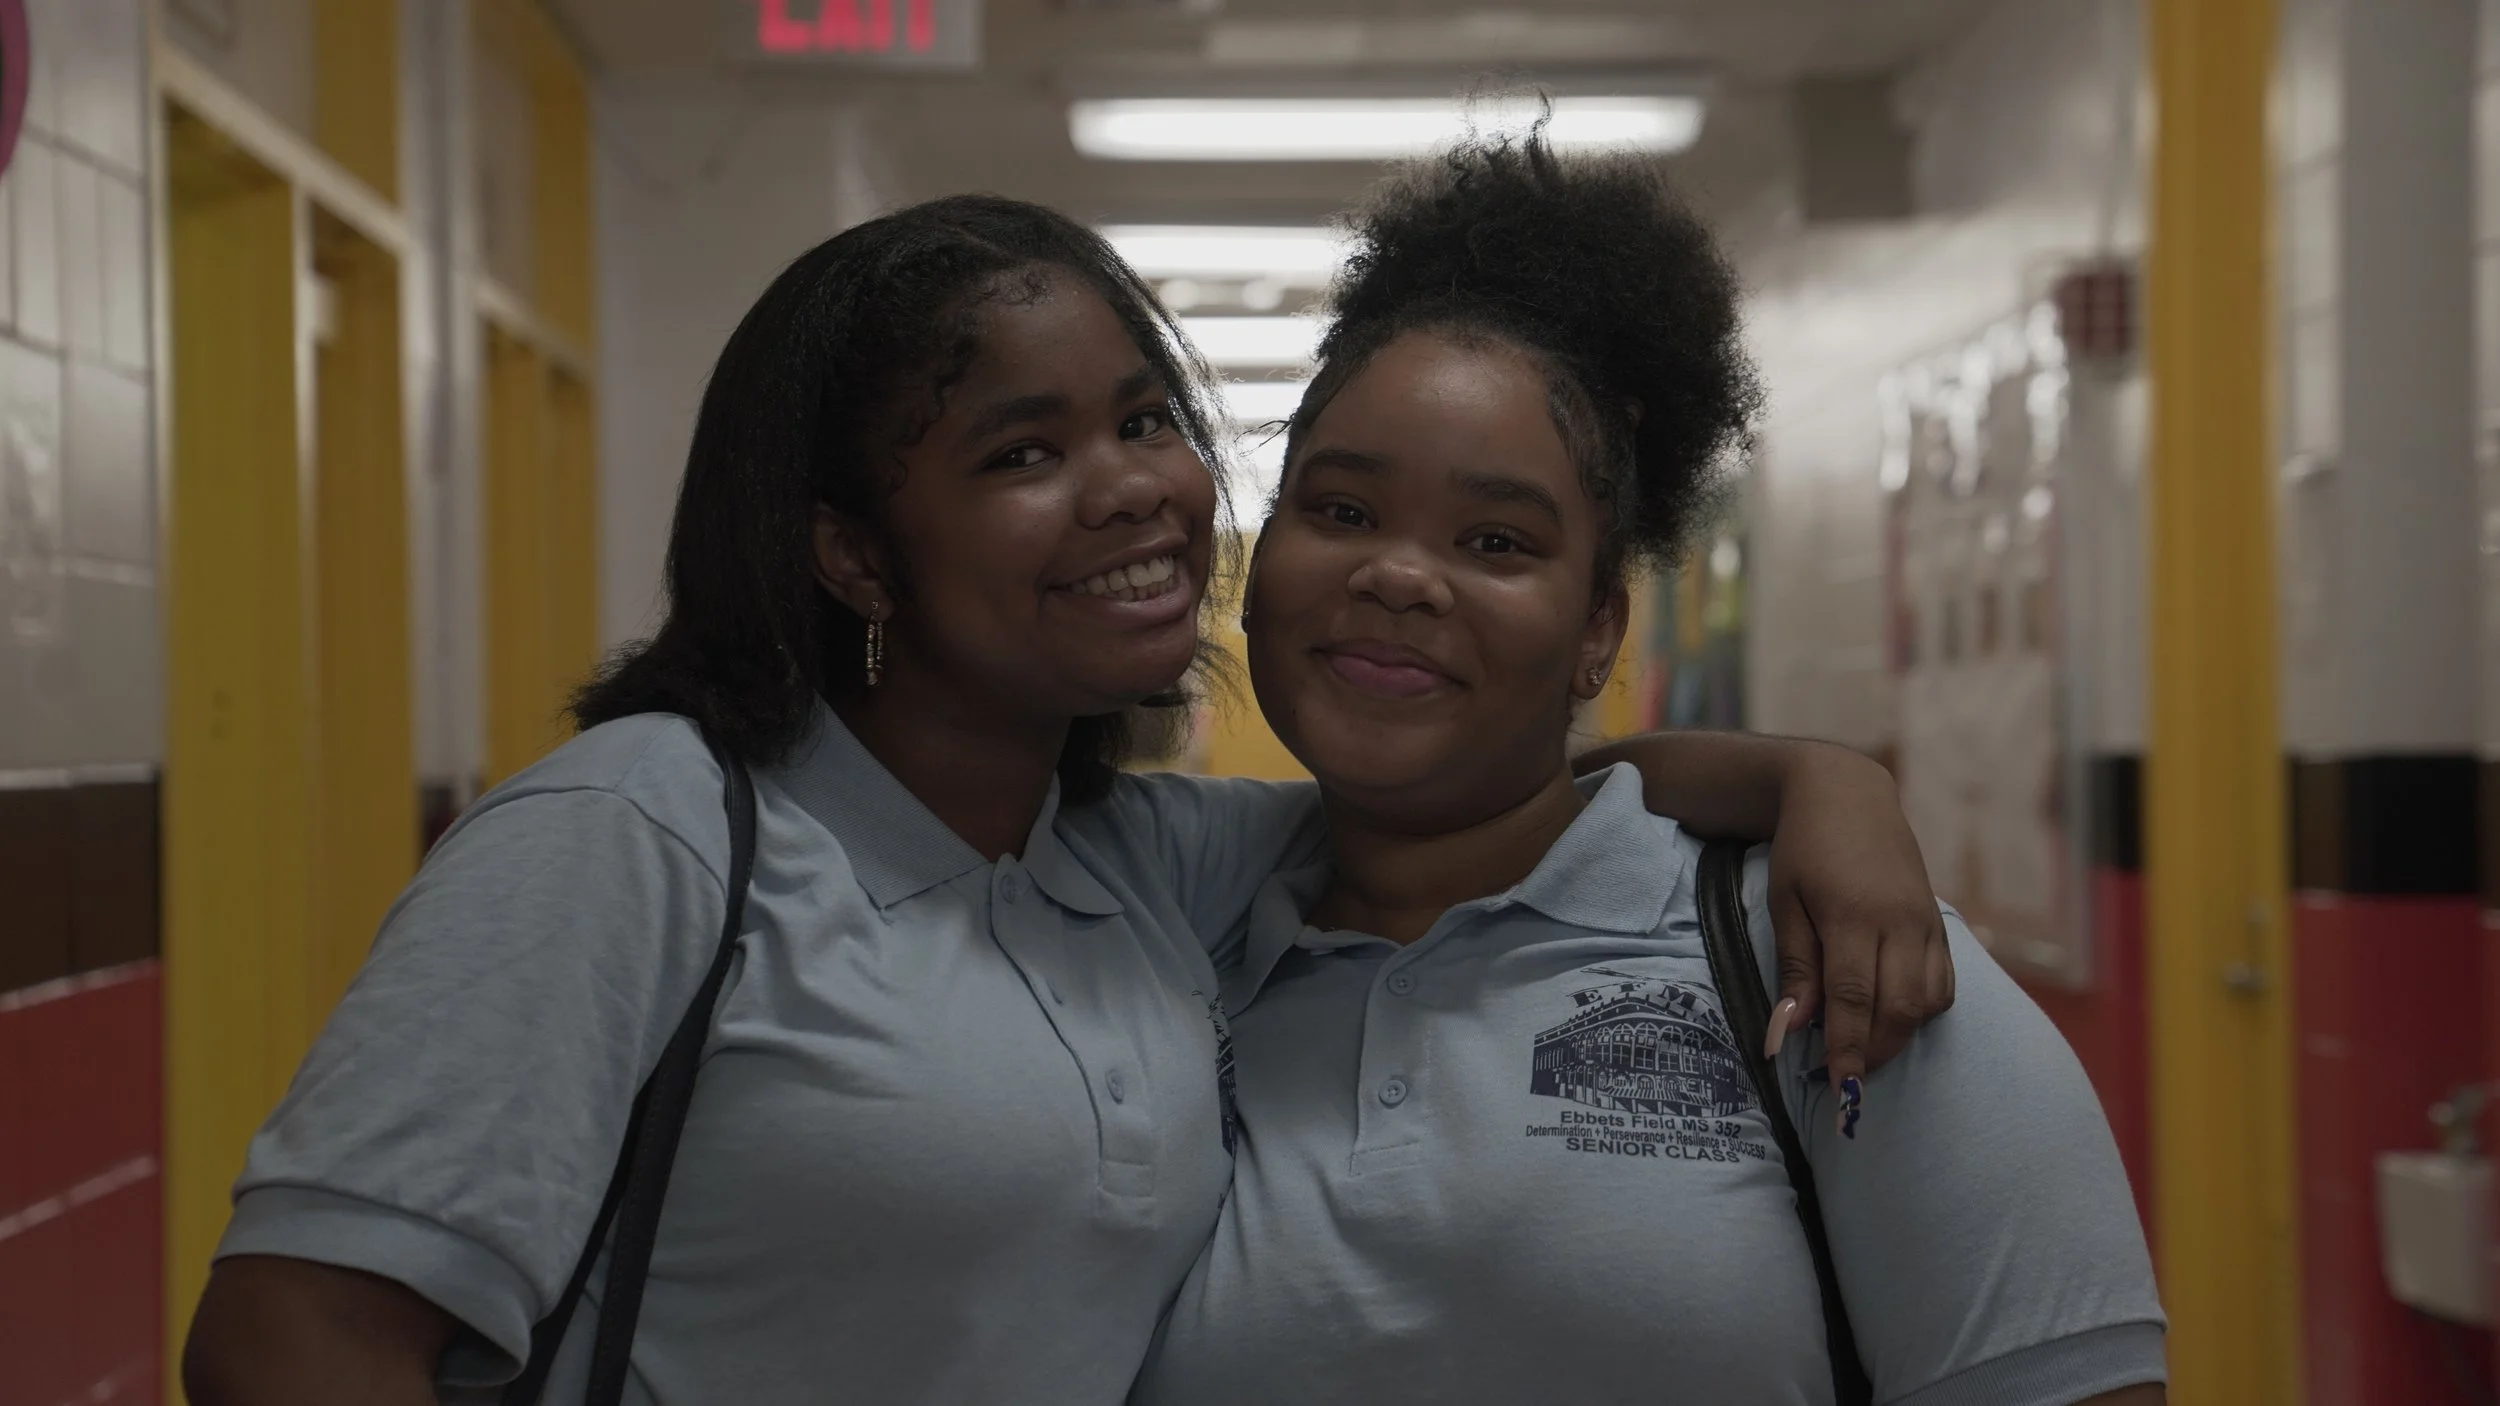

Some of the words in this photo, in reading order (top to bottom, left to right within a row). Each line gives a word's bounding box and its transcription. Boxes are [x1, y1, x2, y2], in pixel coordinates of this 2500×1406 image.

[1560, 1111, 1625, 1127] Ebbets
[1631, 1115, 1676, 1130] Field
[1682, 1118, 1709, 1132] MS
[1715, 1120, 1741, 1138] 352
[1526, 1123, 1593, 1138] Determination
[1603, 1126, 1666, 1144] Perseverance
[1676, 1130, 1720, 1149] Resilience
[1729, 1138, 1766, 1160] SUCCESS
[1566, 1137, 1658, 1157] SENIOR
[1665, 1145, 1741, 1163] CLASS
